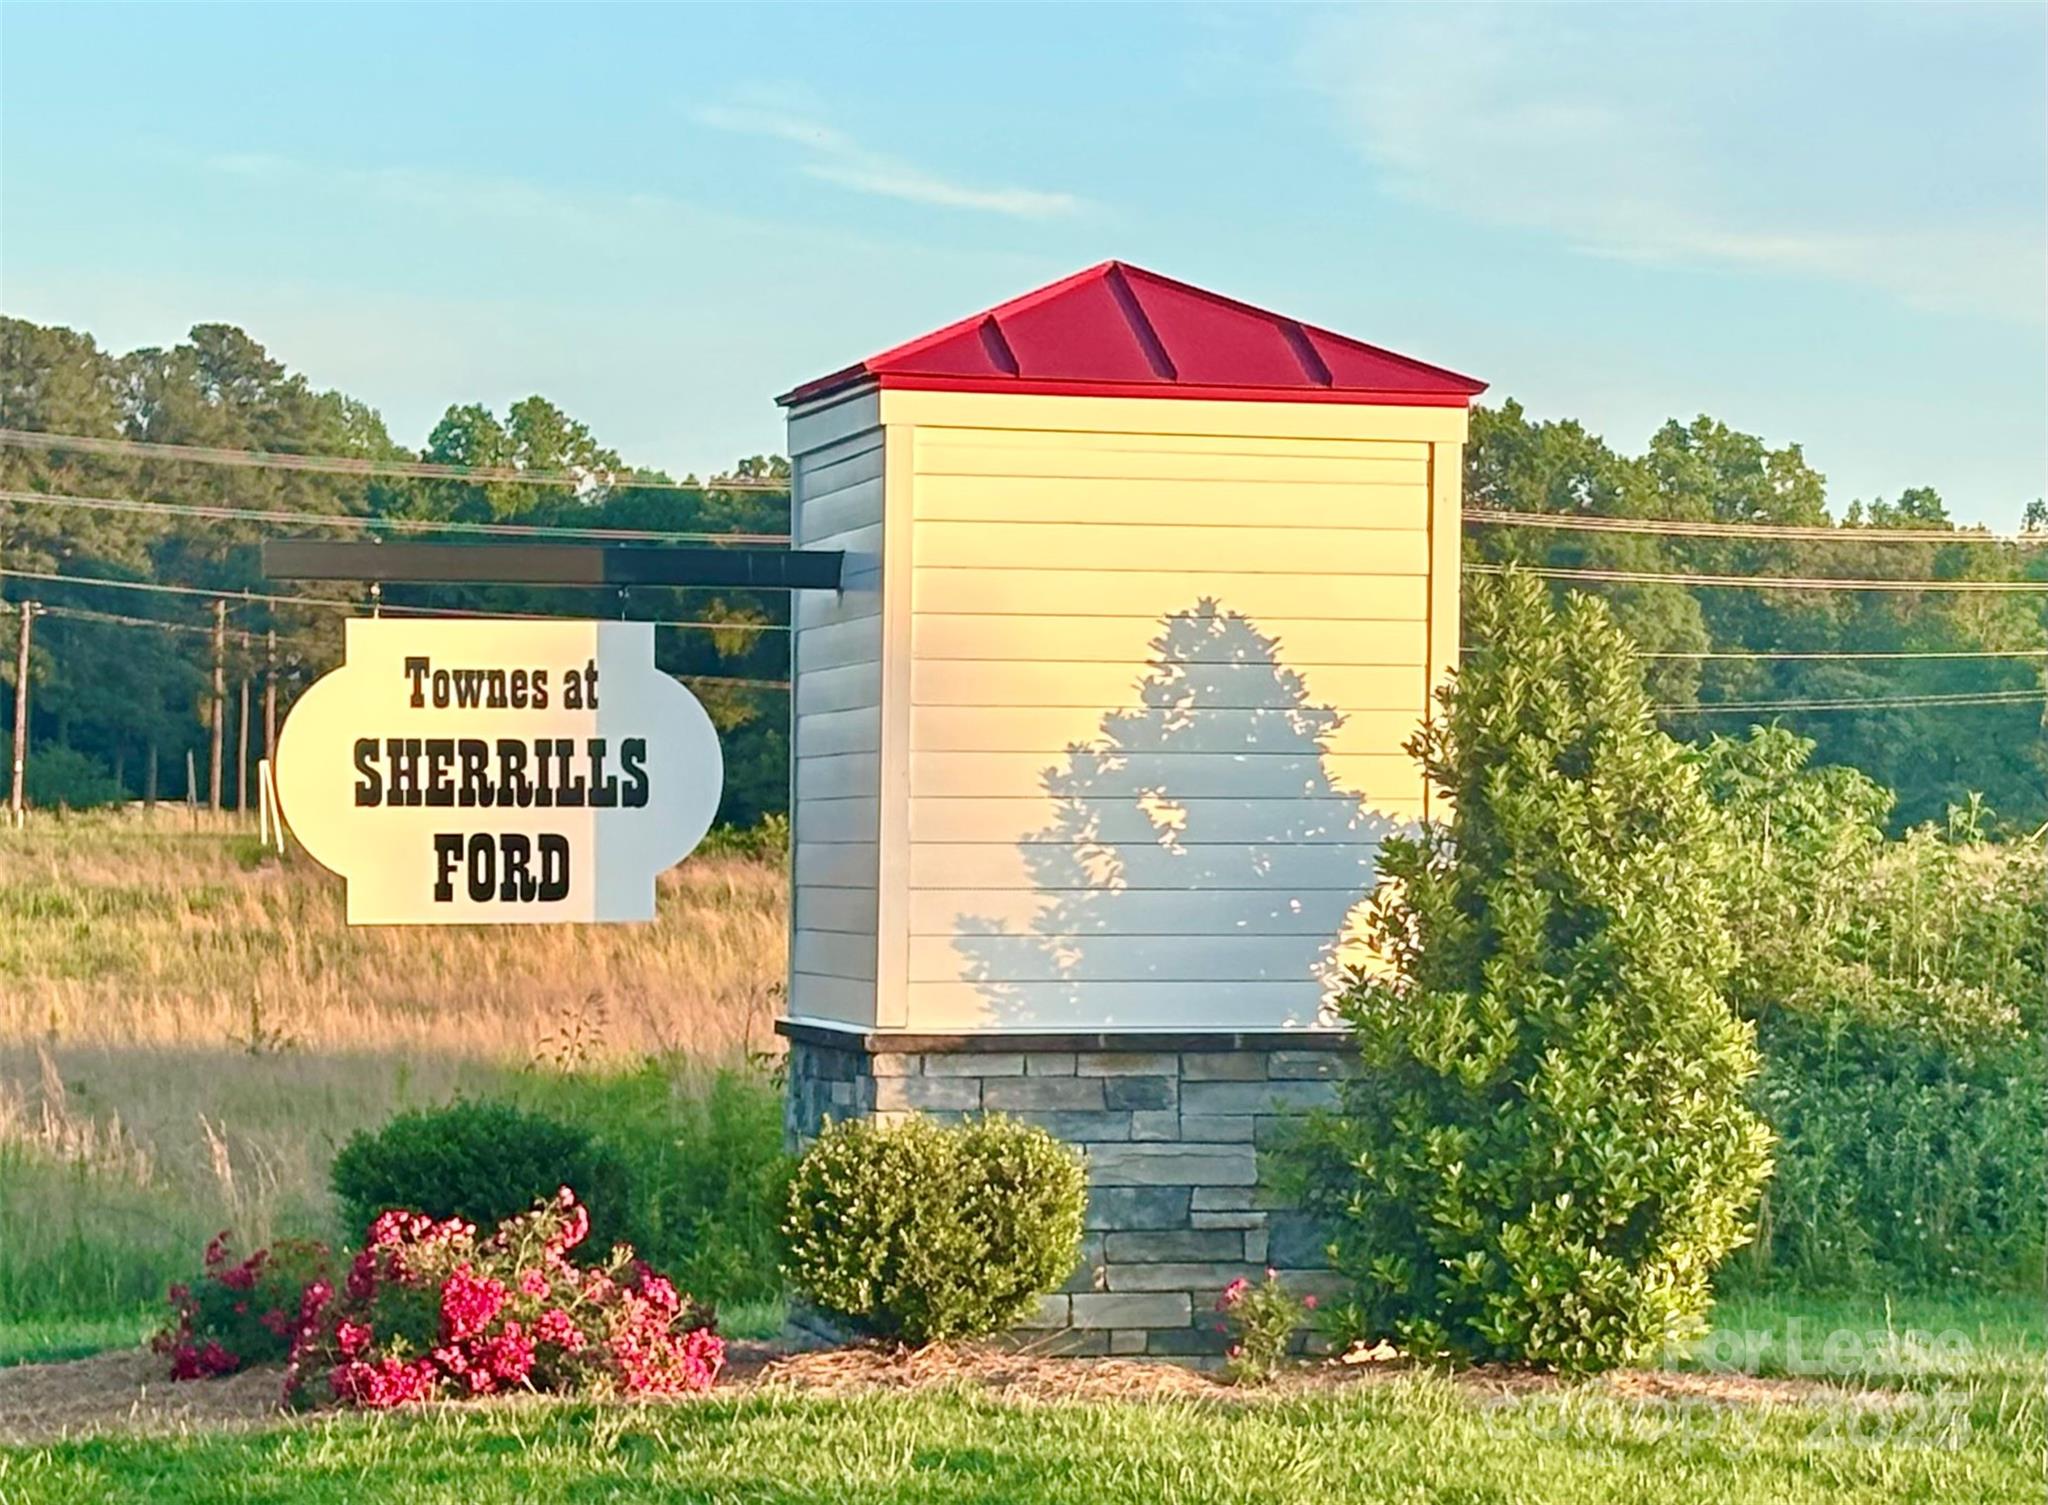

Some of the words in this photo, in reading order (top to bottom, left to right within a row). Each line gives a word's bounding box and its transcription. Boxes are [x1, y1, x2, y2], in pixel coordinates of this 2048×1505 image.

[404, 656, 548, 709] Townes
[563, 658, 600, 710] at
[354, 737, 649, 808] SHERRILLS
[433, 833, 570, 903] FORD
